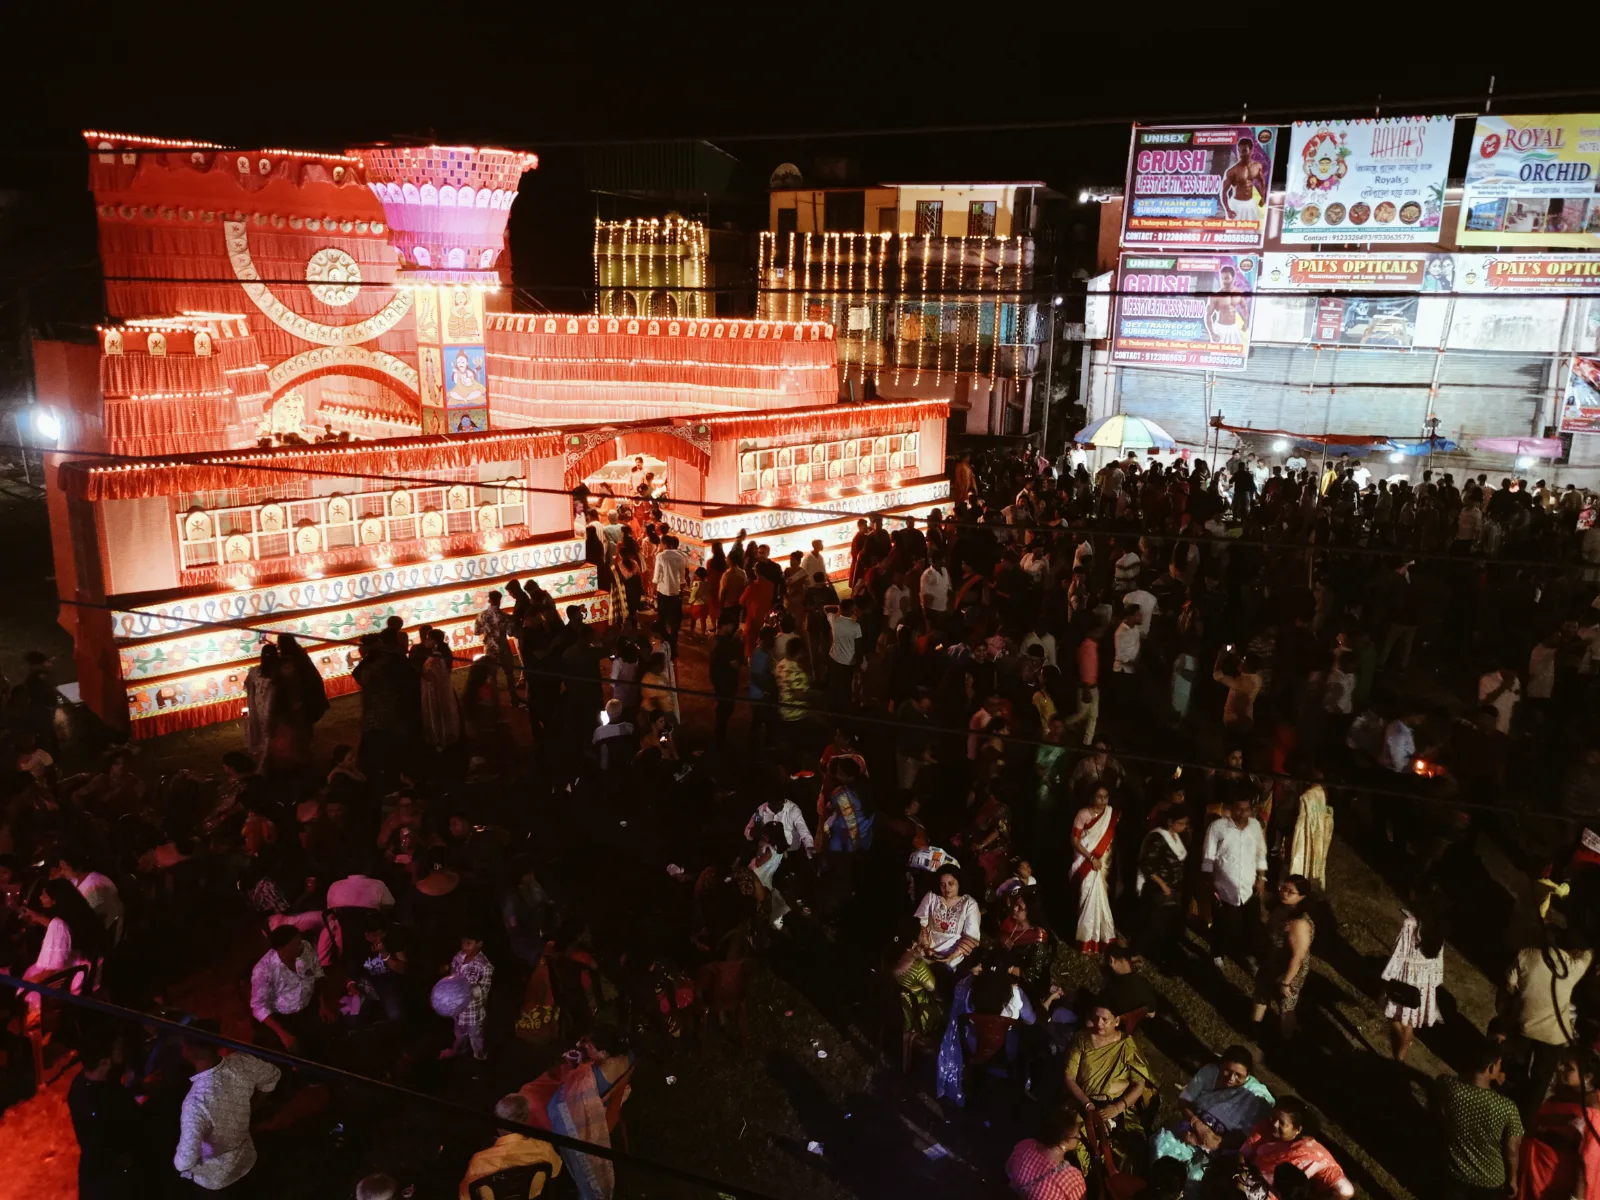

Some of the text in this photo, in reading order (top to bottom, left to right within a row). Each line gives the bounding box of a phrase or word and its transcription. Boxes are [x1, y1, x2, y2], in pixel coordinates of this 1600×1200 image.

[1143, 134, 1185, 143] UNISEX
[1504, 128, 1565, 152] ROYAL
[1137, 150, 1207, 173] CRUSH
[1520, 162, 1591, 182] ORCHID
[1135, 175, 1221, 194] LIFESTYLE FITNESS STUDIO
[1375, 176, 1402, 185] Royals
[1126, 232, 1154, 241] CONTACT
[1130, 259, 1169, 268] UNISEX
[1298, 260, 1419, 274] PAL'S OPTICALS
[1496, 262, 1541, 275] PAL'S
[1124, 274, 1191, 293] CRUSH
[1122, 298, 1205, 318] LIFESTYLE FITNESS STUDIO
[1171, 329, 1197, 337] GHOSH
[1114, 351, 1141, 360] CONTACT
